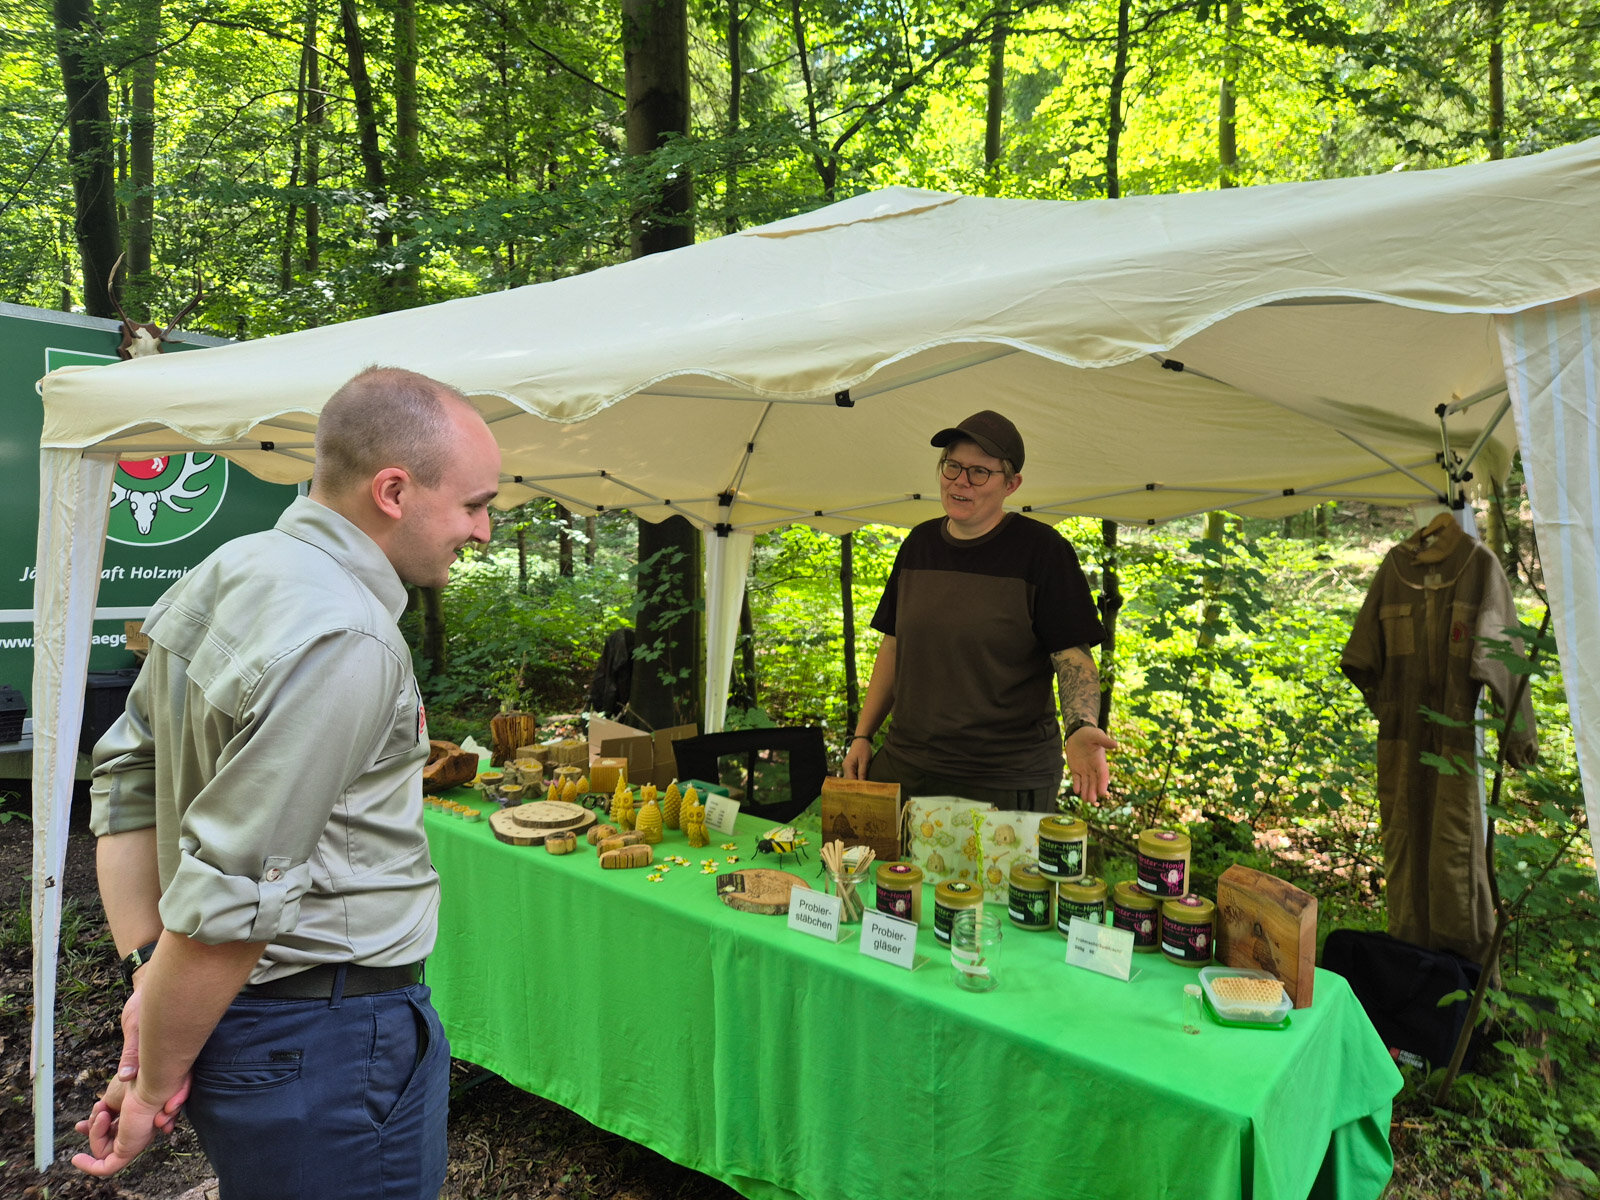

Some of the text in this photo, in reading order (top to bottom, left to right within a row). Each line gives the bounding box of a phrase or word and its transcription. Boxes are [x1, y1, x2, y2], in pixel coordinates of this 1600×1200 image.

[799, 899, 832, 916] Probier-
[795, 912, 833, 931] stäbchen
[871, 923, 907, 941] Probier-
[873, 939, 901, 955] gläser
